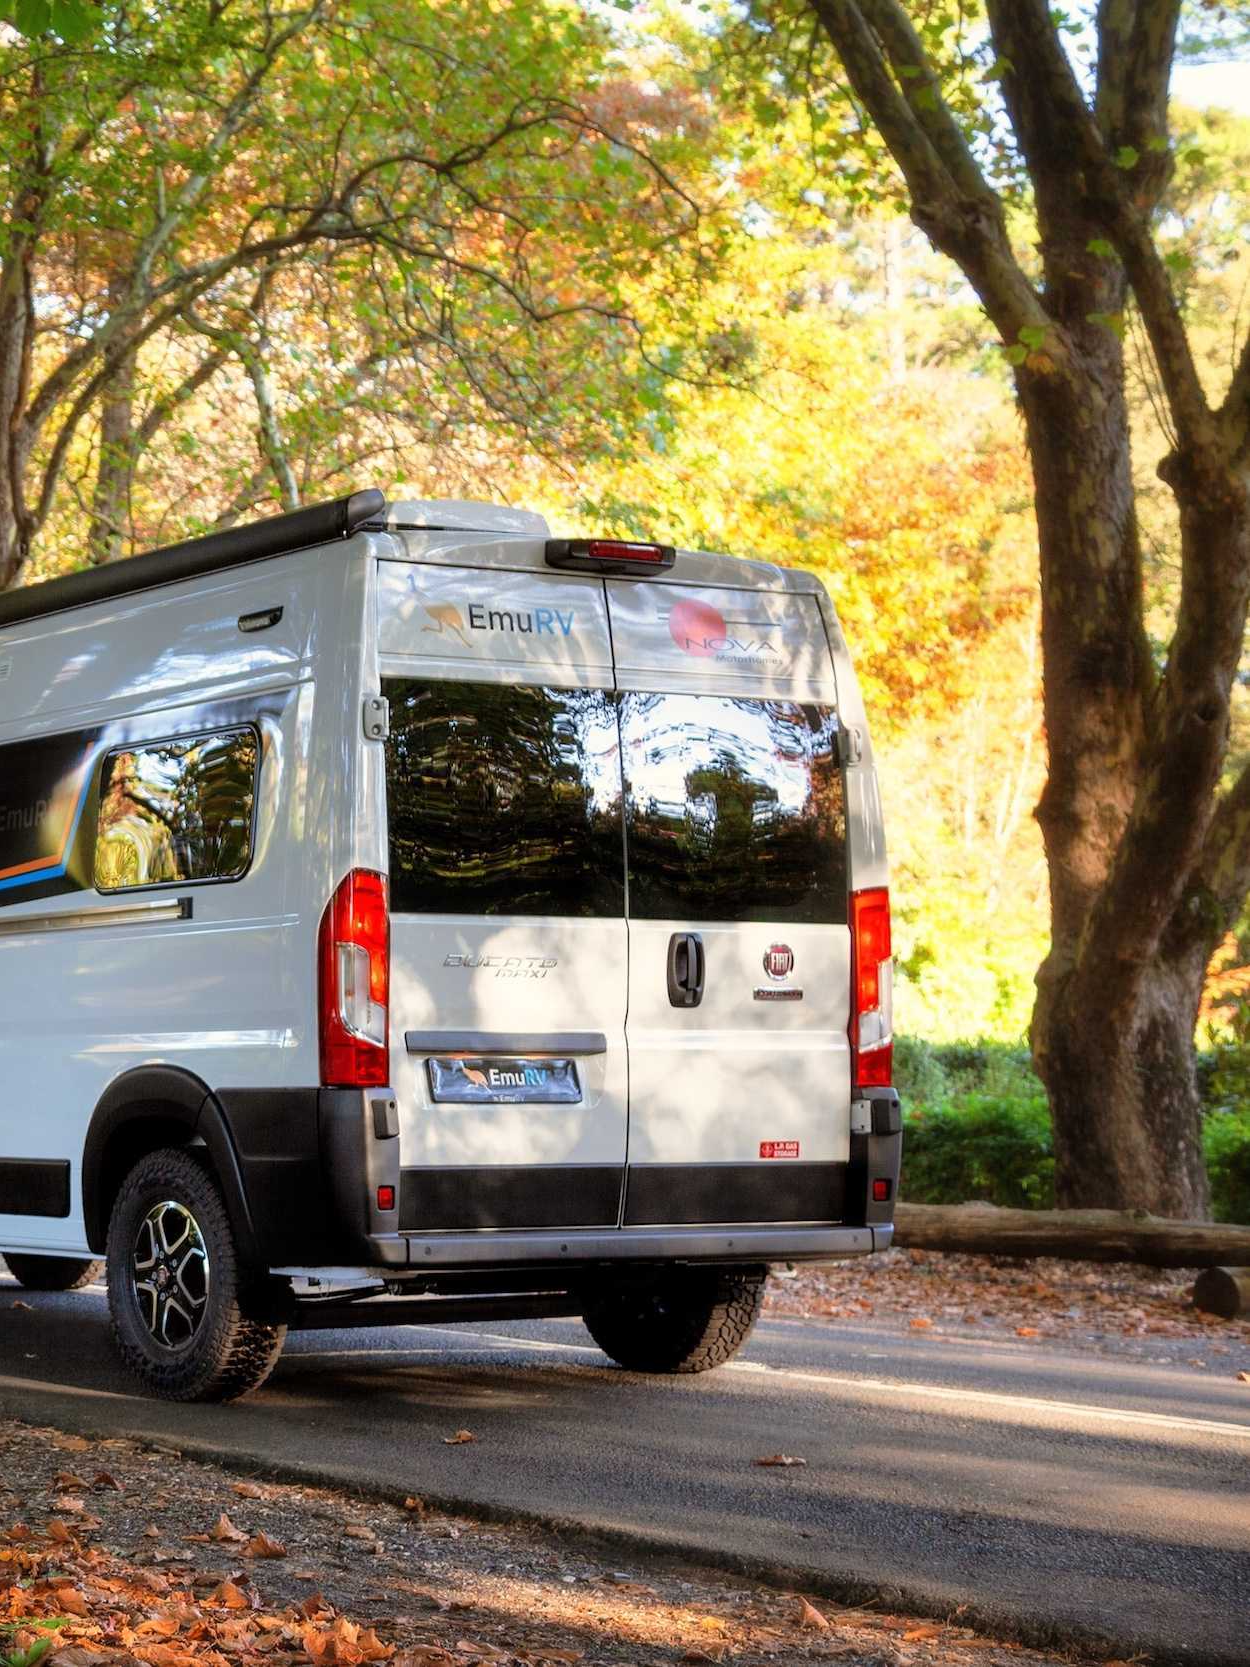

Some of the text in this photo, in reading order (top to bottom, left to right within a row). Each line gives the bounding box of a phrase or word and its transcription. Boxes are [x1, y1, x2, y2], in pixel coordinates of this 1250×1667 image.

[468, 603, 575, 636] EmuRV
[685, 638, 779, 653] NOVA
[442, 954, 558, 968] DUCATO
[770, 952, 791, 971] FIAT
[489, 1068, 546, 1085] EmuRV
